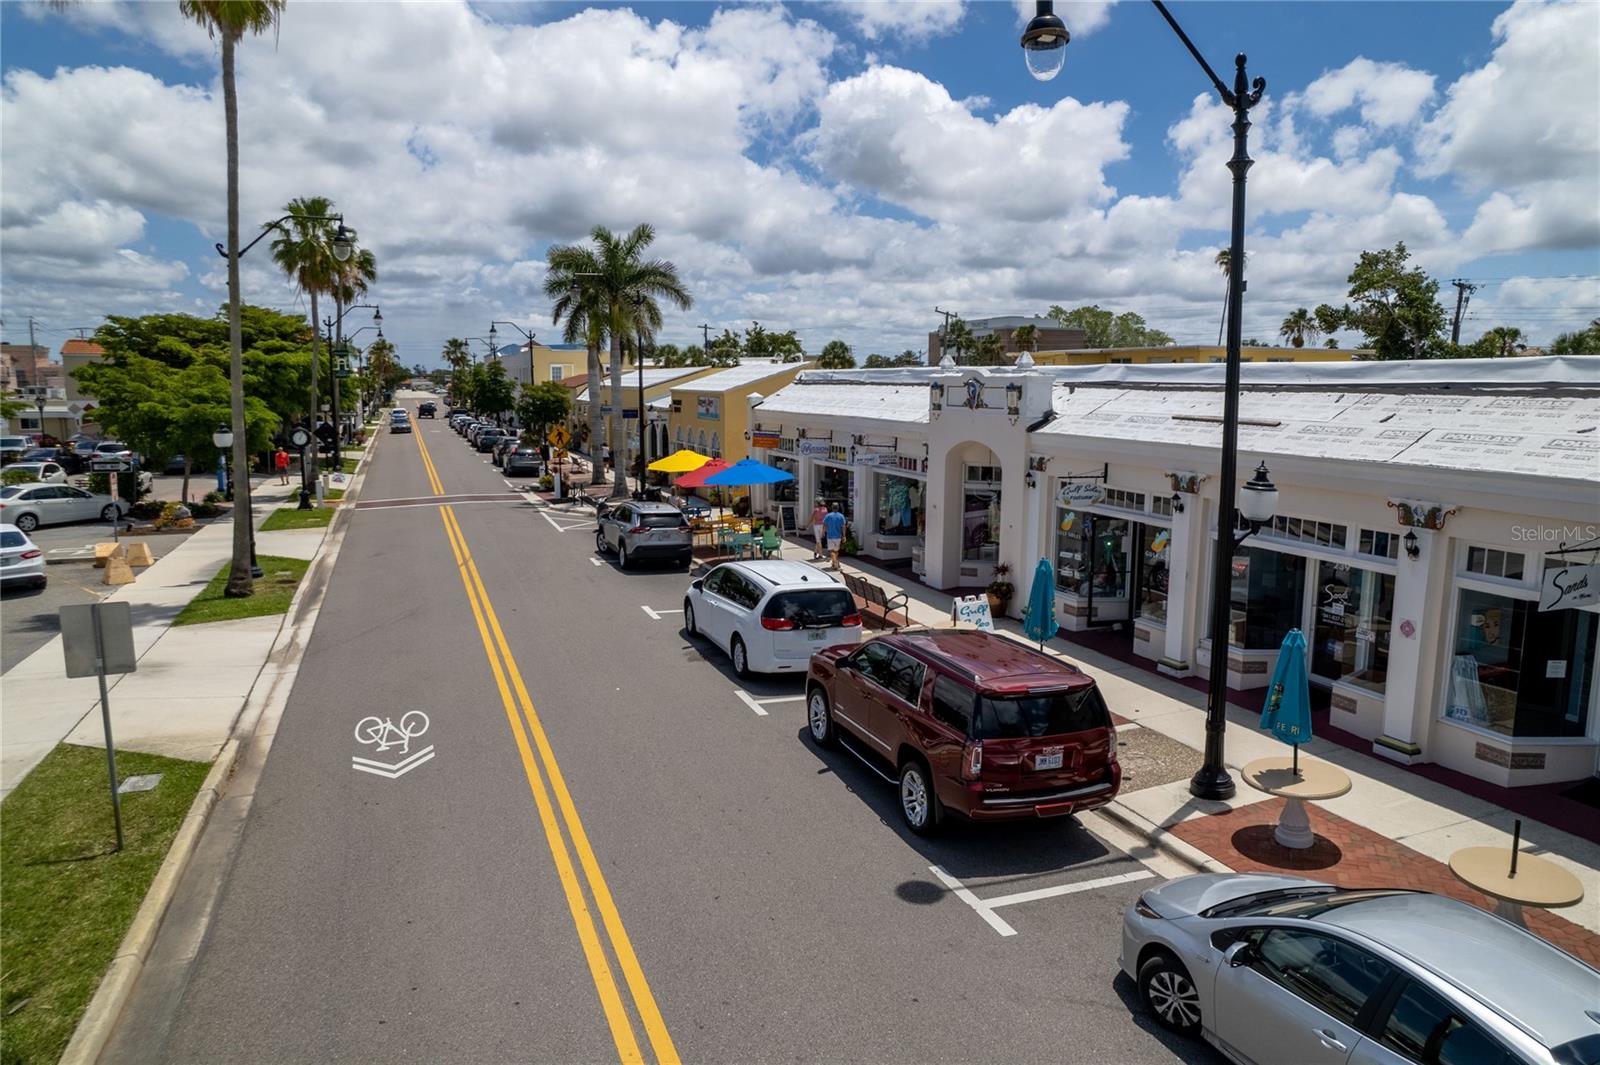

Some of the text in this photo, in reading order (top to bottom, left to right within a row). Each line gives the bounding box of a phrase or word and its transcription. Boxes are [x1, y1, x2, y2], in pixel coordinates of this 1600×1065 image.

[1323, 584, 1352, 606] Sands
[1546, 570, 1589, 610] Sands
[960, 604, 989, 617] Gulf
